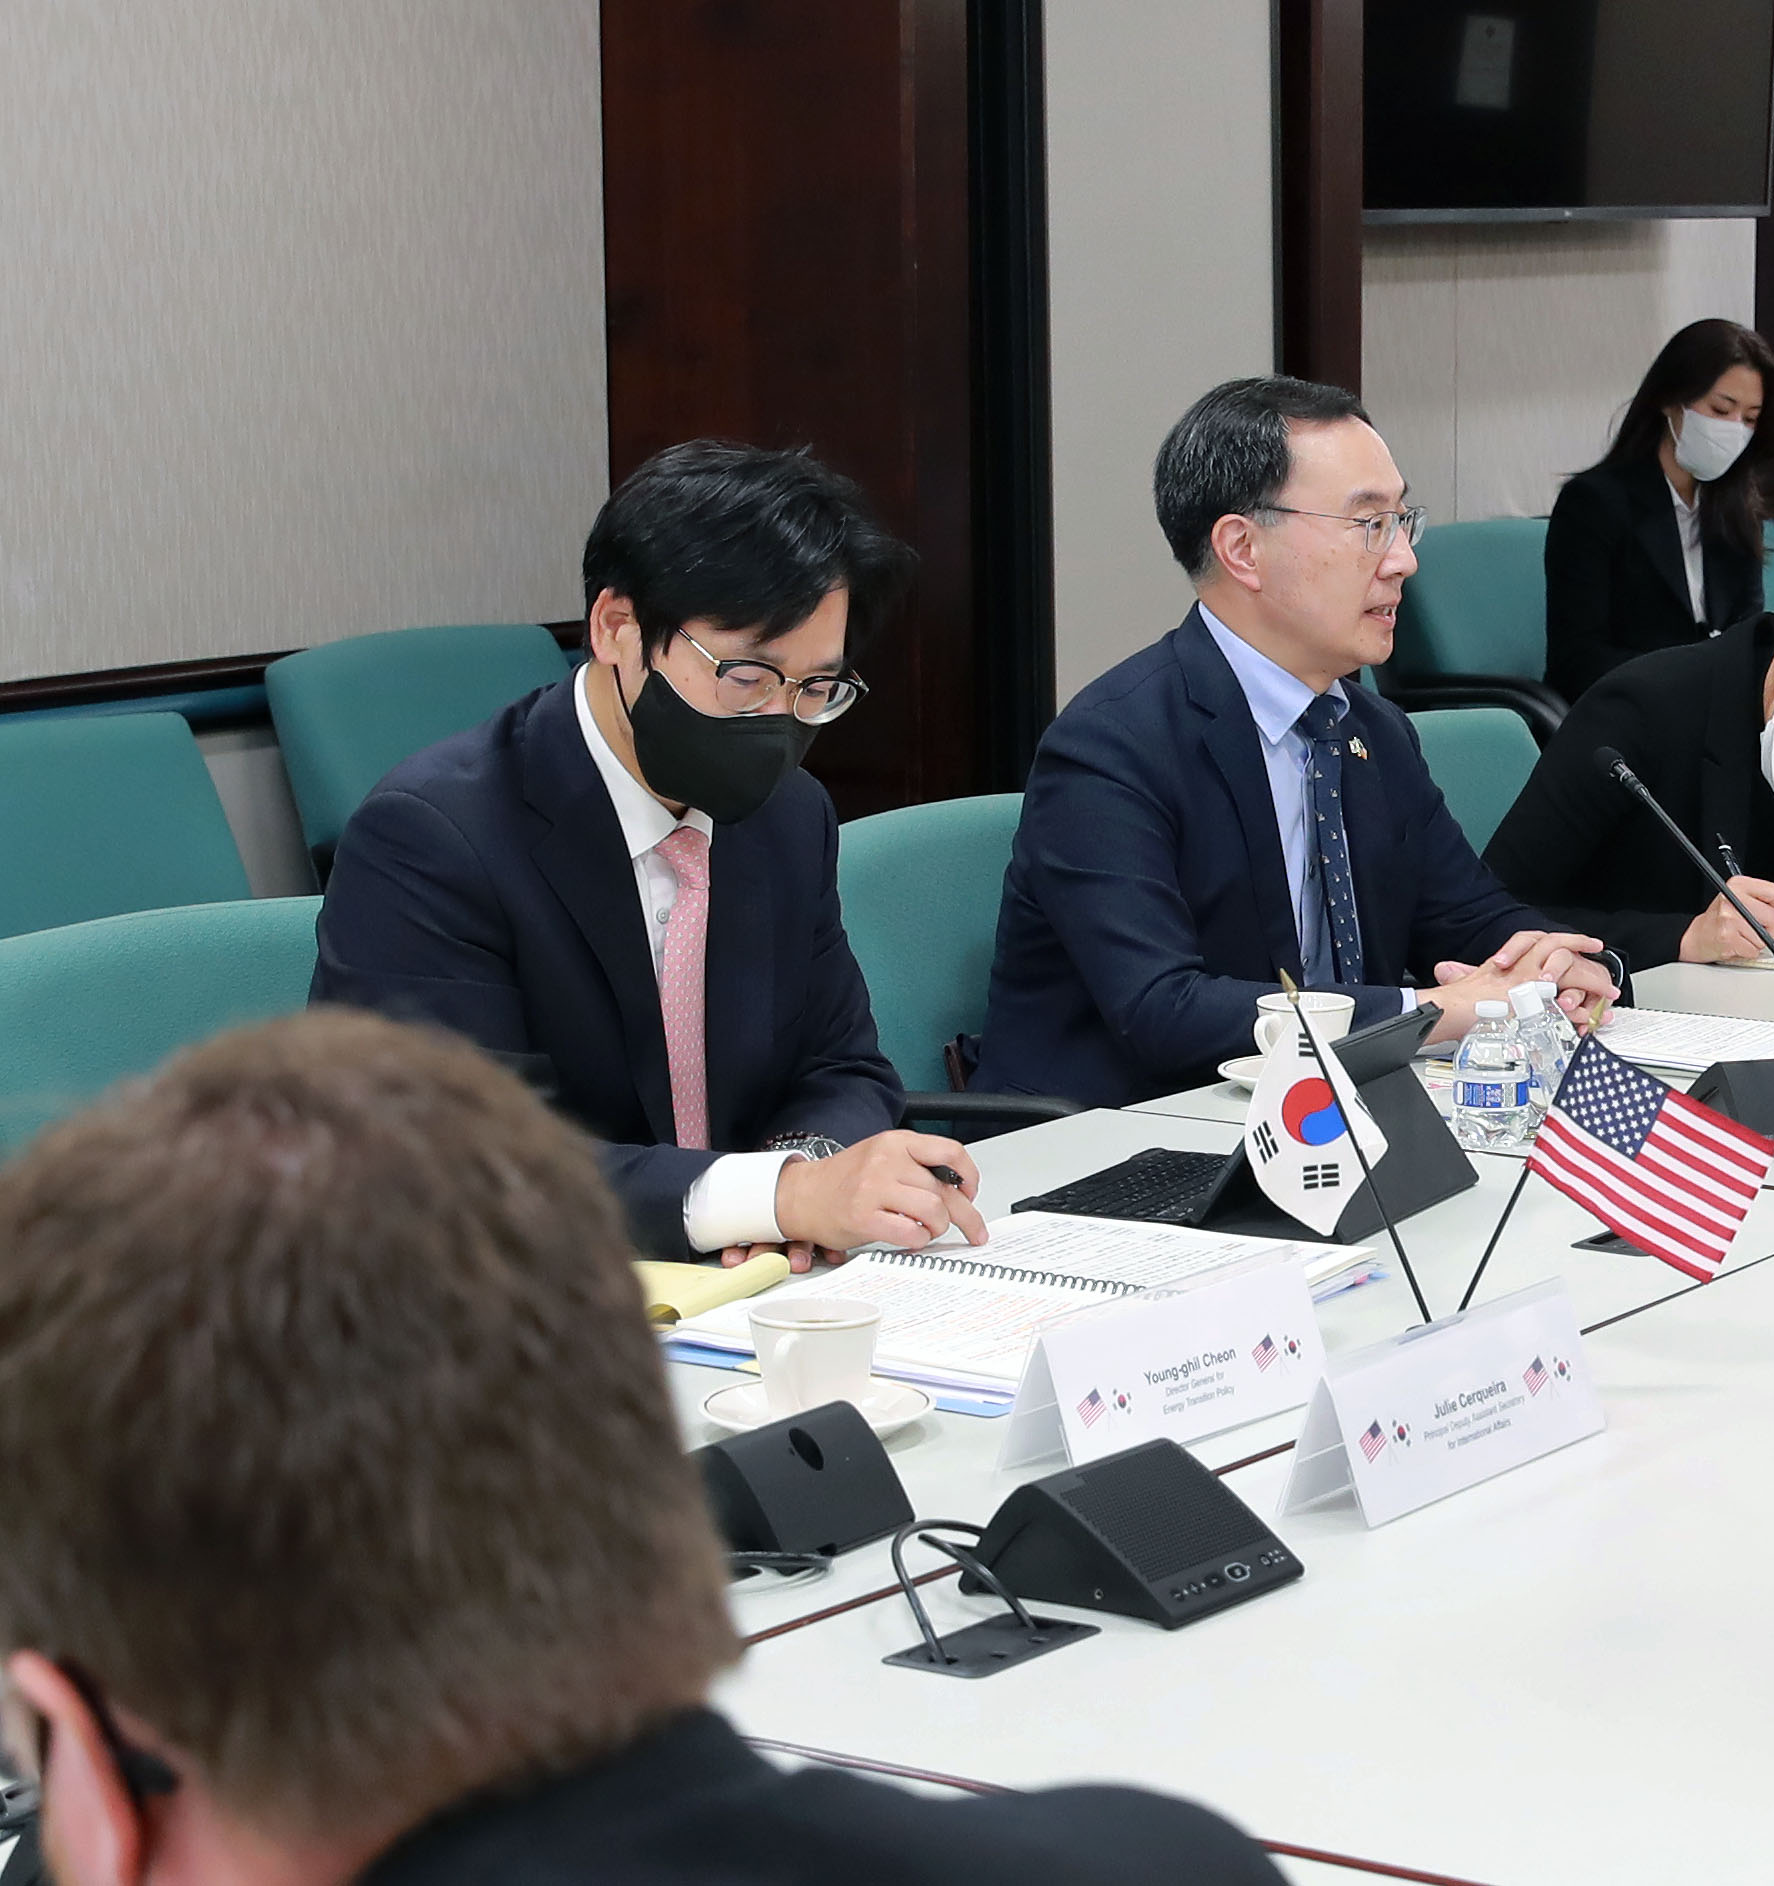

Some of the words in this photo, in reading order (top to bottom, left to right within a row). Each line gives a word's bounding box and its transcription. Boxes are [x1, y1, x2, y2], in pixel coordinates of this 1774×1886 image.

[1144, 1355, 1201, 1385] Young-ghil
[1202, 1348, 1237, 1368] Cheon
[1434, 1398, 1458, 1419] Julie
[1458, 1380, 1507, 1408] Cerqueira
